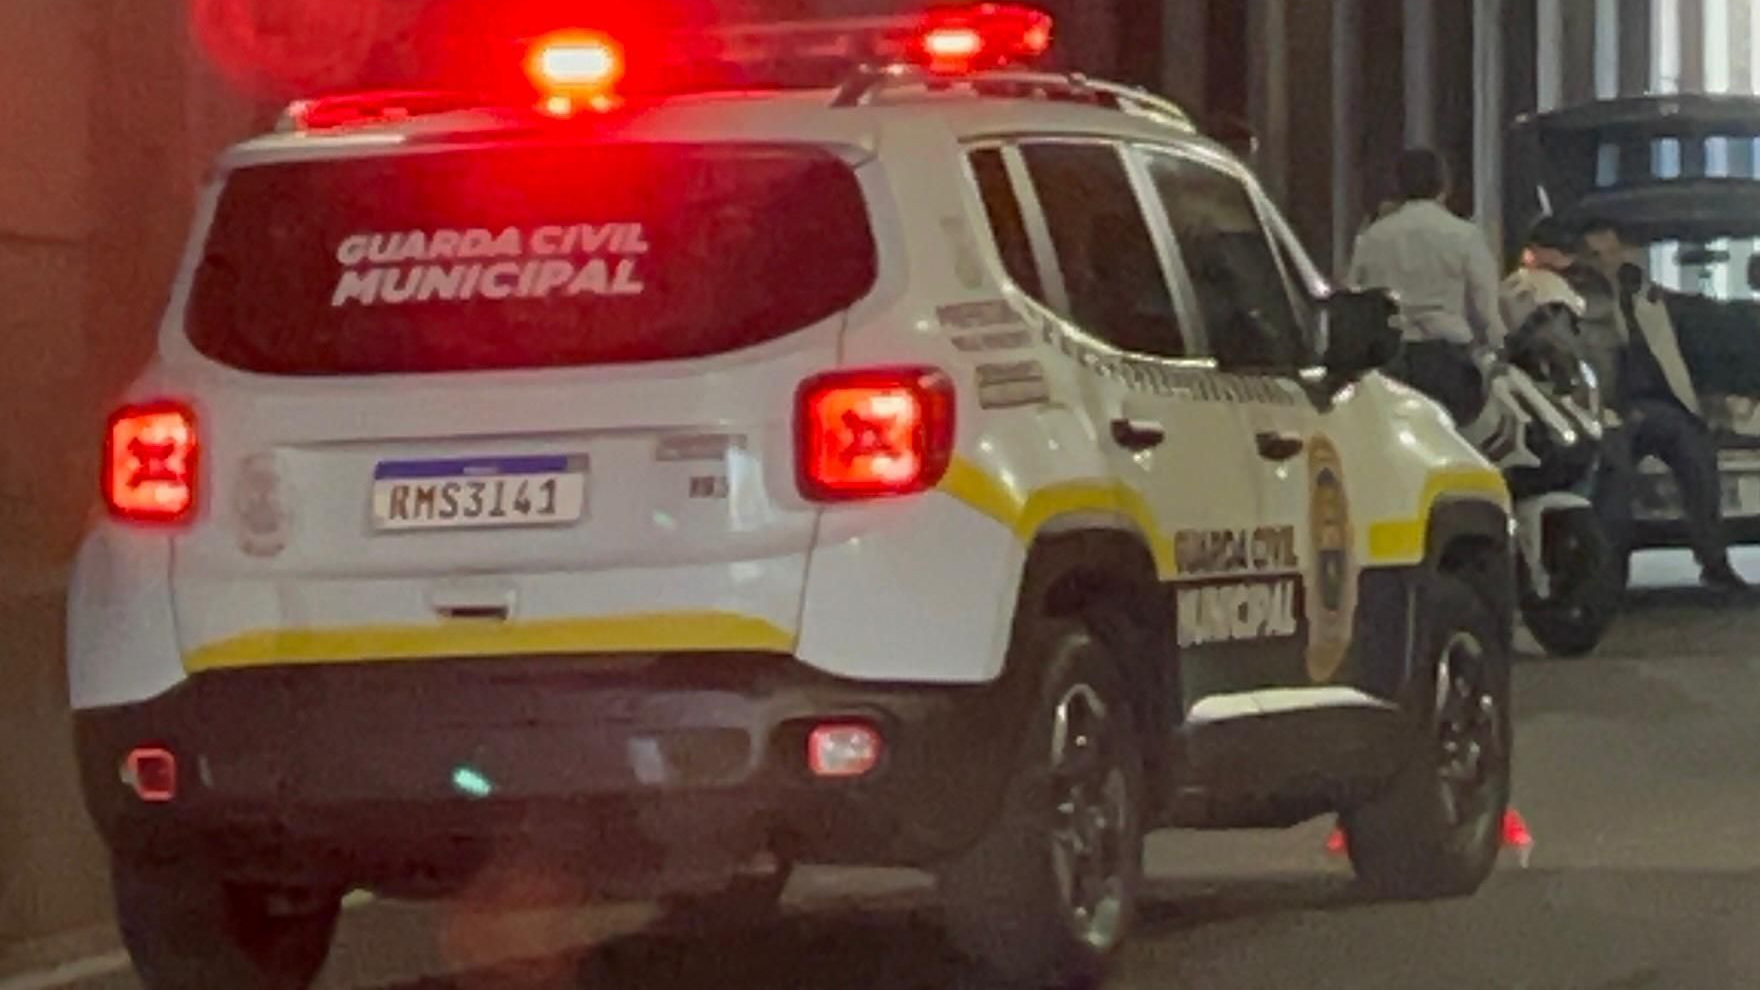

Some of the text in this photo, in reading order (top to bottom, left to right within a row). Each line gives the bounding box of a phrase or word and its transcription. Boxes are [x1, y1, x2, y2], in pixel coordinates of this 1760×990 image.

[337, 222, 648, 264] GUARDA CIVIL
[331, 259, 644, 306] MUNICIPAL
